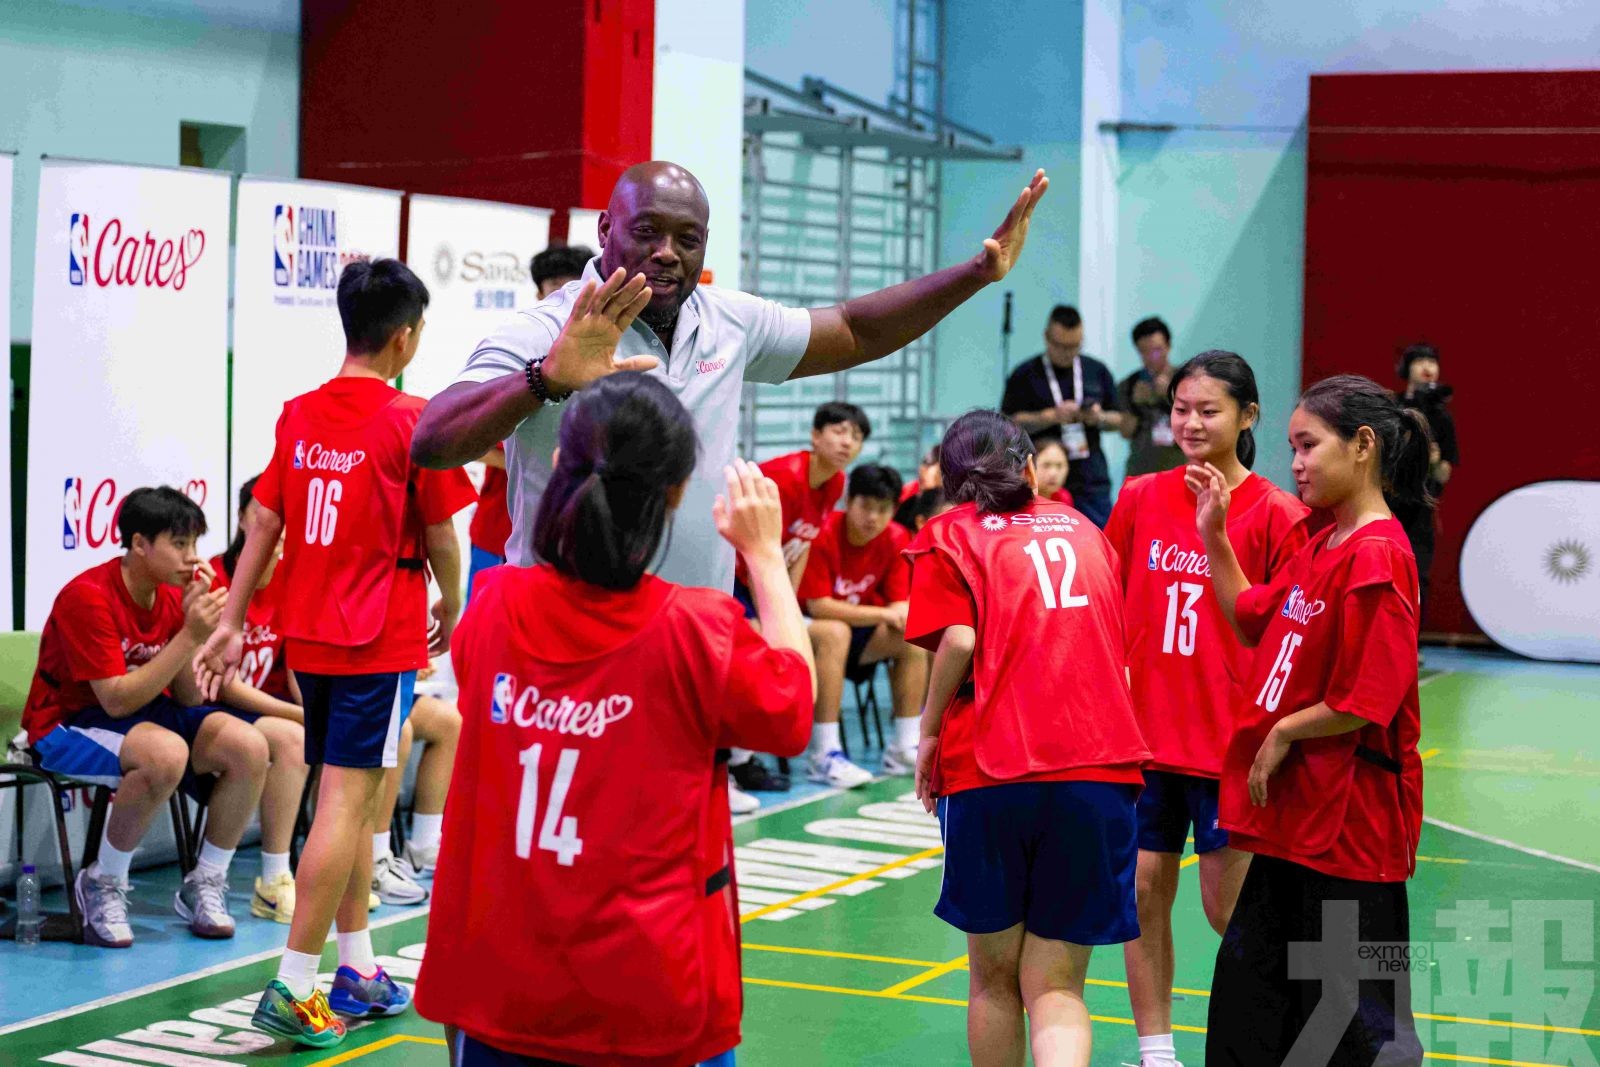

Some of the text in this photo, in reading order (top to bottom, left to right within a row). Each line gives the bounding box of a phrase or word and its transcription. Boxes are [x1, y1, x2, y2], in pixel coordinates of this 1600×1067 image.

[93, 218, 205, 291] Cares
[298, 206, 336, 247] CHINA
[297, 249, 337, 289] GAMES
[306, 443, 365, 474] Cares
[305, 477, 343, 547] 06
[1010, 513, 1080, 526] Sands
[1023, 537, 1089, 609] 12
[1162, 581, 1204, 656] 13
[1255, 630, 1303, 713] 15
[513, 685, 633, 738] Cares
[515, 742, 583, 866] 14
